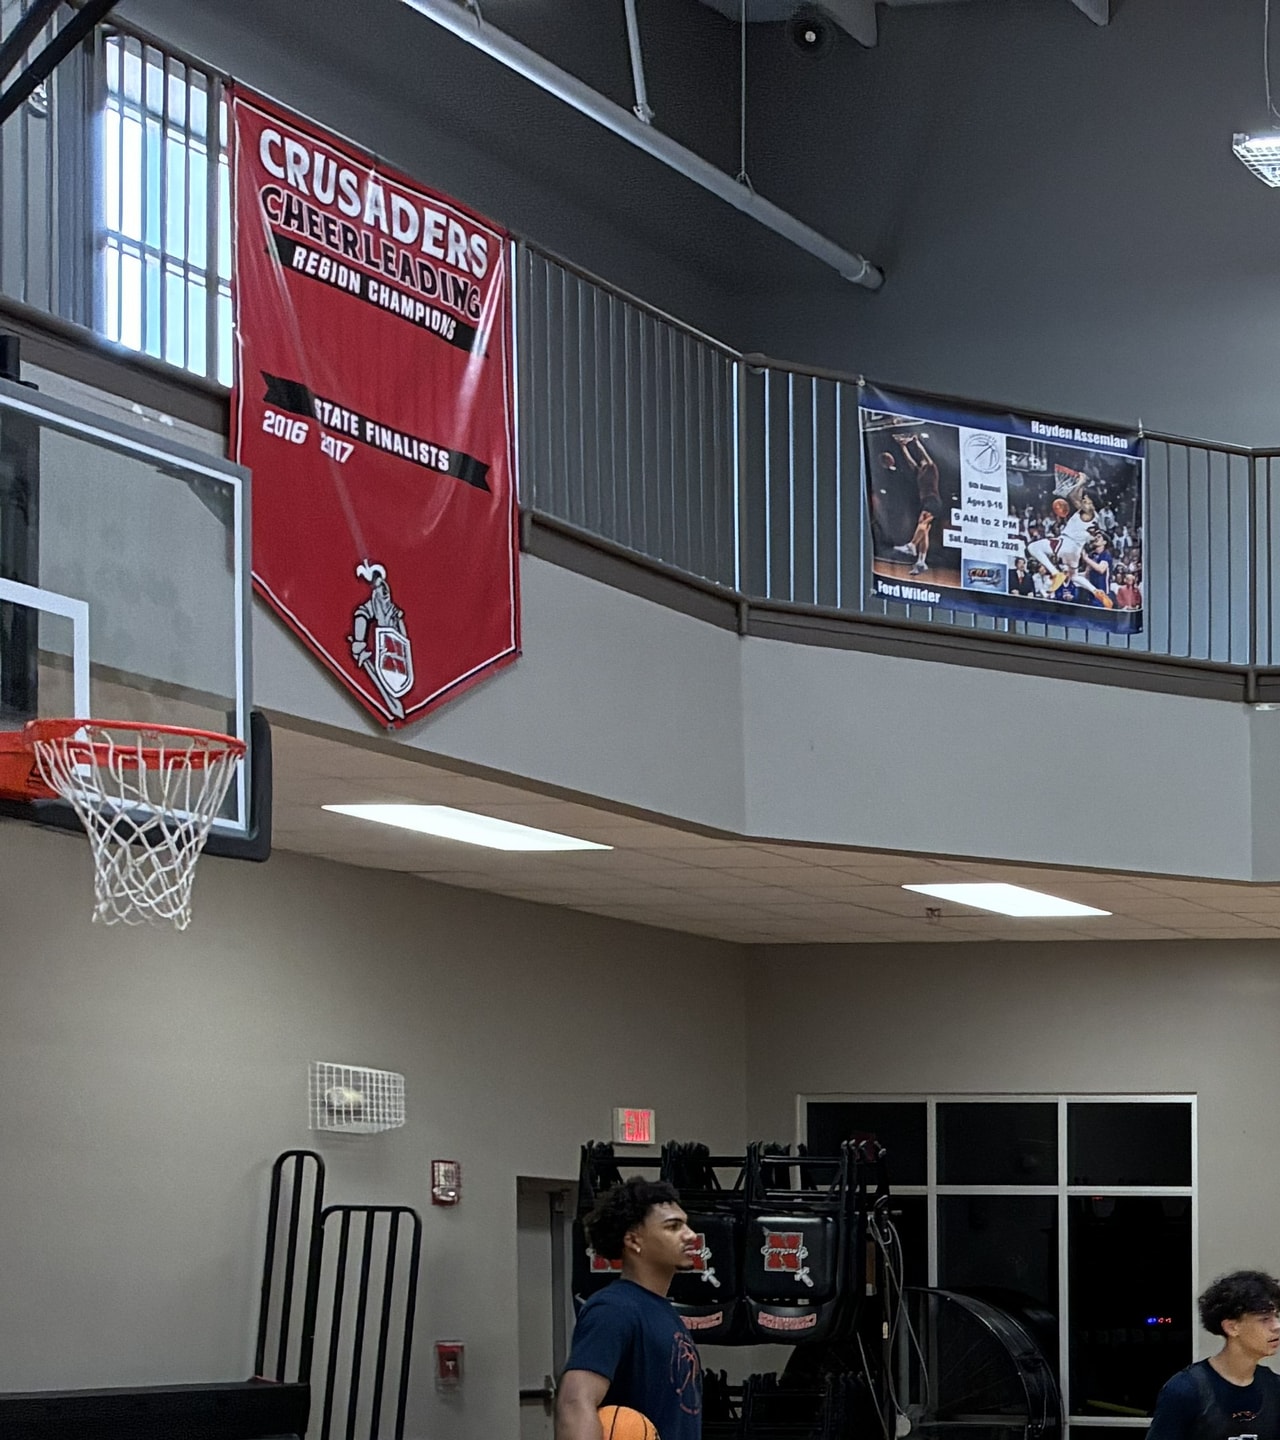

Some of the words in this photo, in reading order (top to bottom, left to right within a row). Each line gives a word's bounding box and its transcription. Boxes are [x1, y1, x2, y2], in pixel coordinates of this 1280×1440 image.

[259, 128, 488, 280] CRUSADERS
[260, 184, 482, 321] CHEERLEADING
[292, 245, 361, 294] REGION
[368, 275, 456, 341] CHAMPIONS
[262, 410, 309, 445] 2016
[313, 397, 359, 438] STATE
[365, 421, 450, 472] FINALISTS
[1031, 420, 1073, 440] Hayden
[962, 514, 979, 523] AM
[981, 517, 992, 526] to
[993, 519, 1000, 527] 2
[1002, 520, 1017, 529] PM
[878, 580, 900, 597] Ford
[901, 586, 940, 603] Wilder
